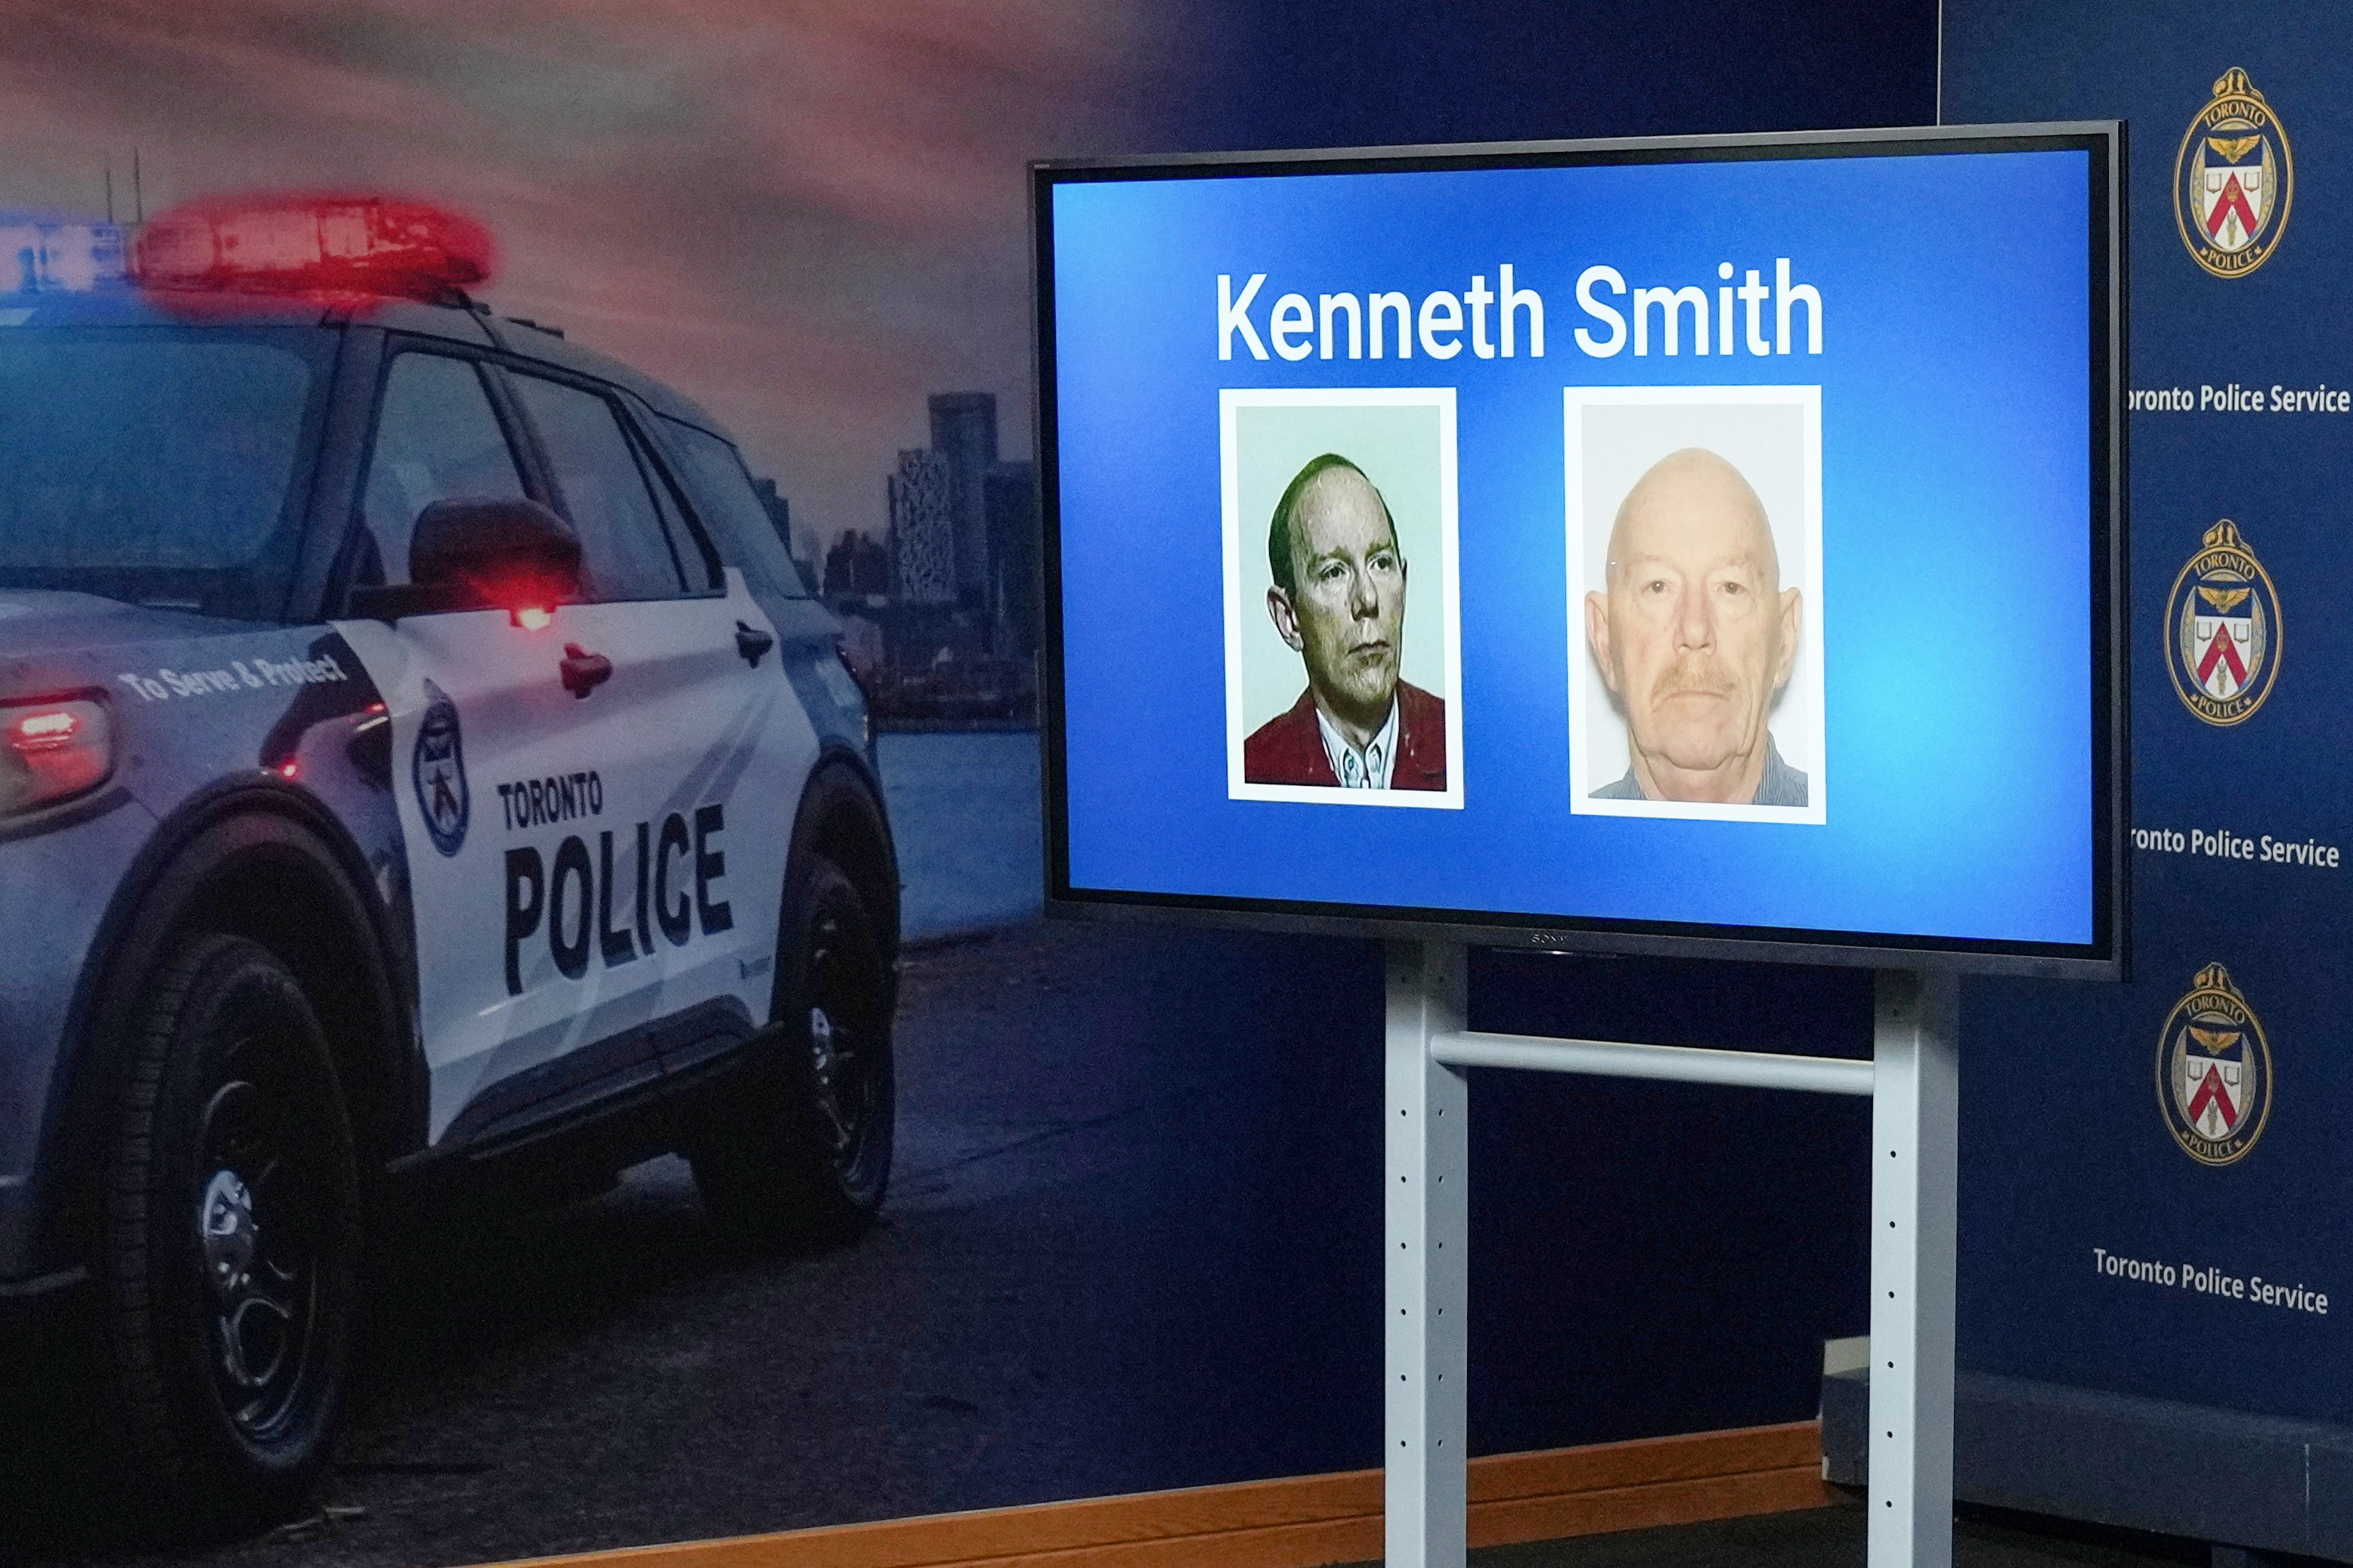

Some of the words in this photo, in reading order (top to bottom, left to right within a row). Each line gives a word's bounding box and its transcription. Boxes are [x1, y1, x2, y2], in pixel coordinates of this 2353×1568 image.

[2203, 99, 2268, 128] TORONTO
[2206, 248, 2255, 270] POLICE
[1216, 263, 1546, 362] Kenneth
[1573, 257, 1825, 359] Smith
[2200, 385, 2265, 412] Police
[2270, 384, 2350, 412] Service
[2194, 552, 2256, 582] TORONTO
[117, 673, 169, 701] To
[2197, 698, 2245, 719] POLICE
[497, 770, 603, 830] TORONTO
[2191, 829, 2255, 860] Police
[2259, 835, 2340, 868] Service
[503, 803, 735, 997] POLICE
[2186, 996, 2246, 1025] TORONTO
[2188, 1135, 2234, 1158] POLICE
[2094, 1248, 2177, 1286] Toronto
[2181, 1263, 2244, 1299] Police
[2249, 1277, 2329, 1314] Service
